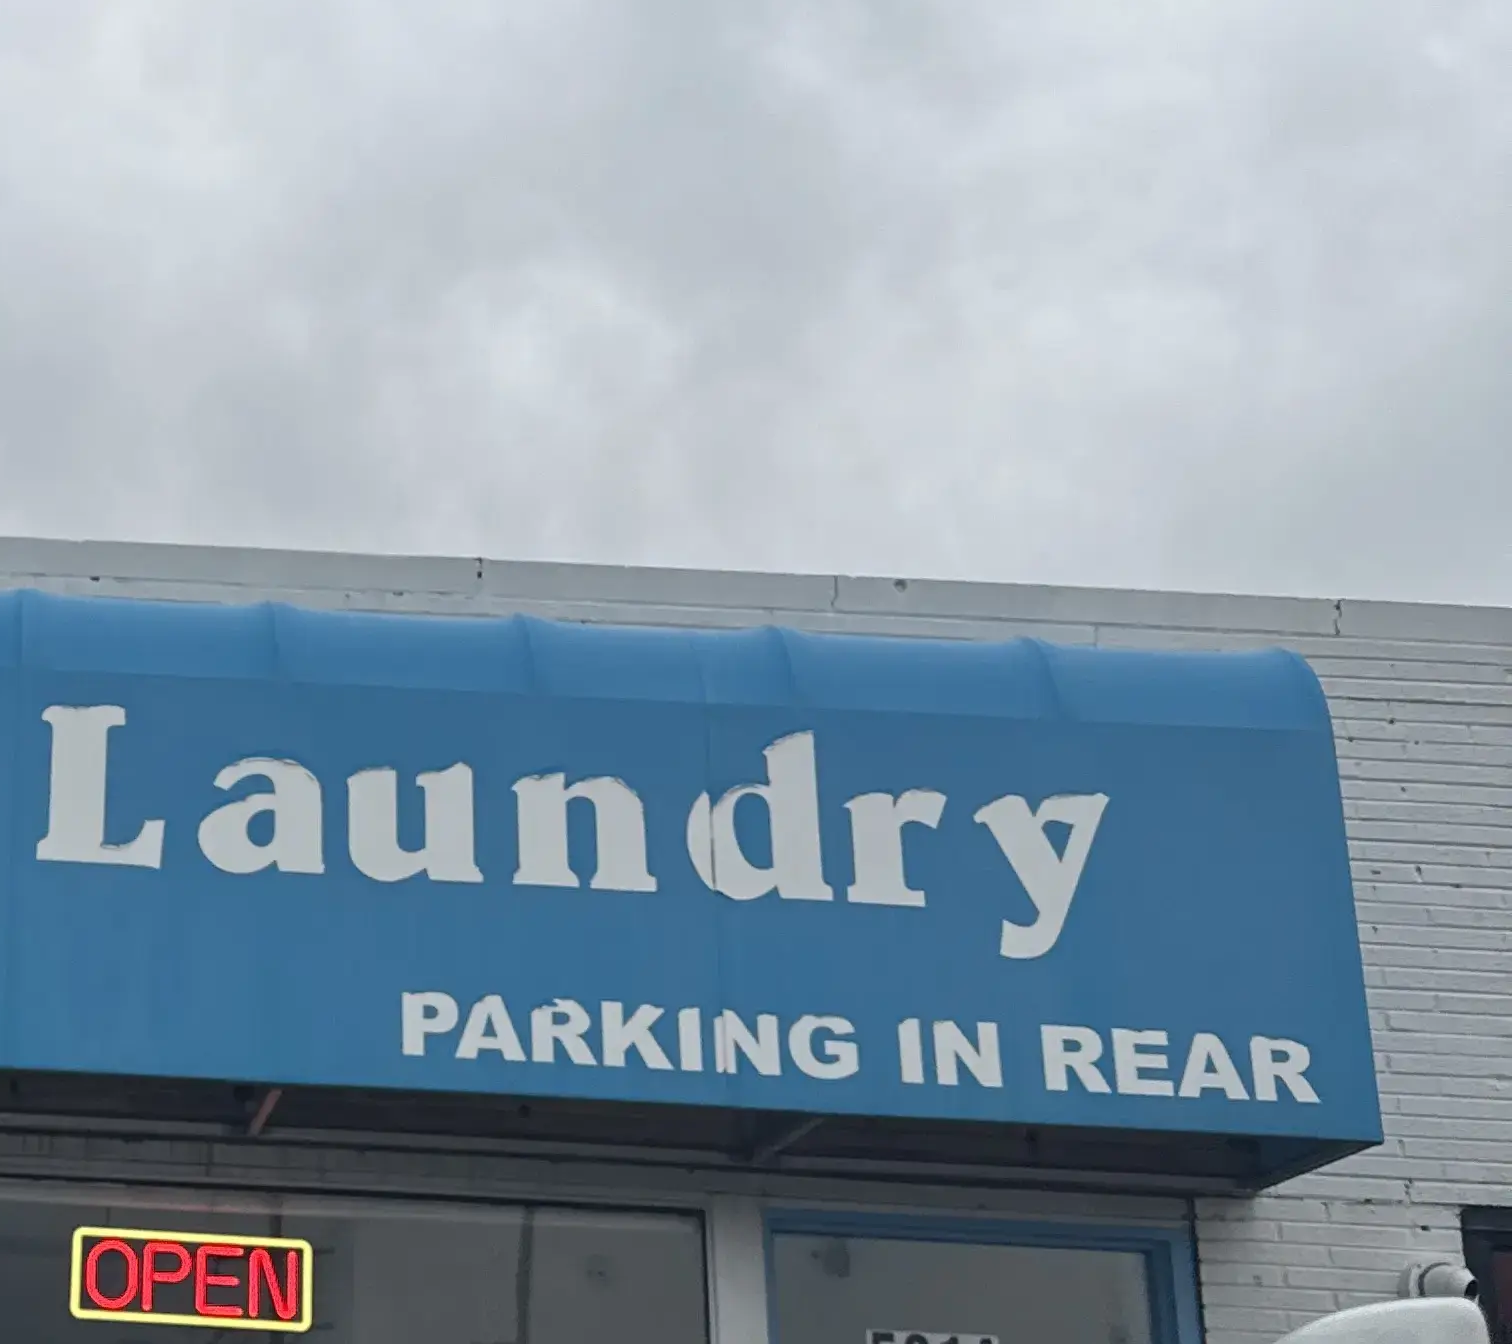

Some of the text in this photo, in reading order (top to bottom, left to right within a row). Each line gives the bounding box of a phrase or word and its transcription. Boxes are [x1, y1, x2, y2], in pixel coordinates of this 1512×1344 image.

[36, 705, 1109, 960] Laundry
[401, 991, 1320, 1104] PARKING IN REAR
[84, 1236, 300, 1321] OPEN
